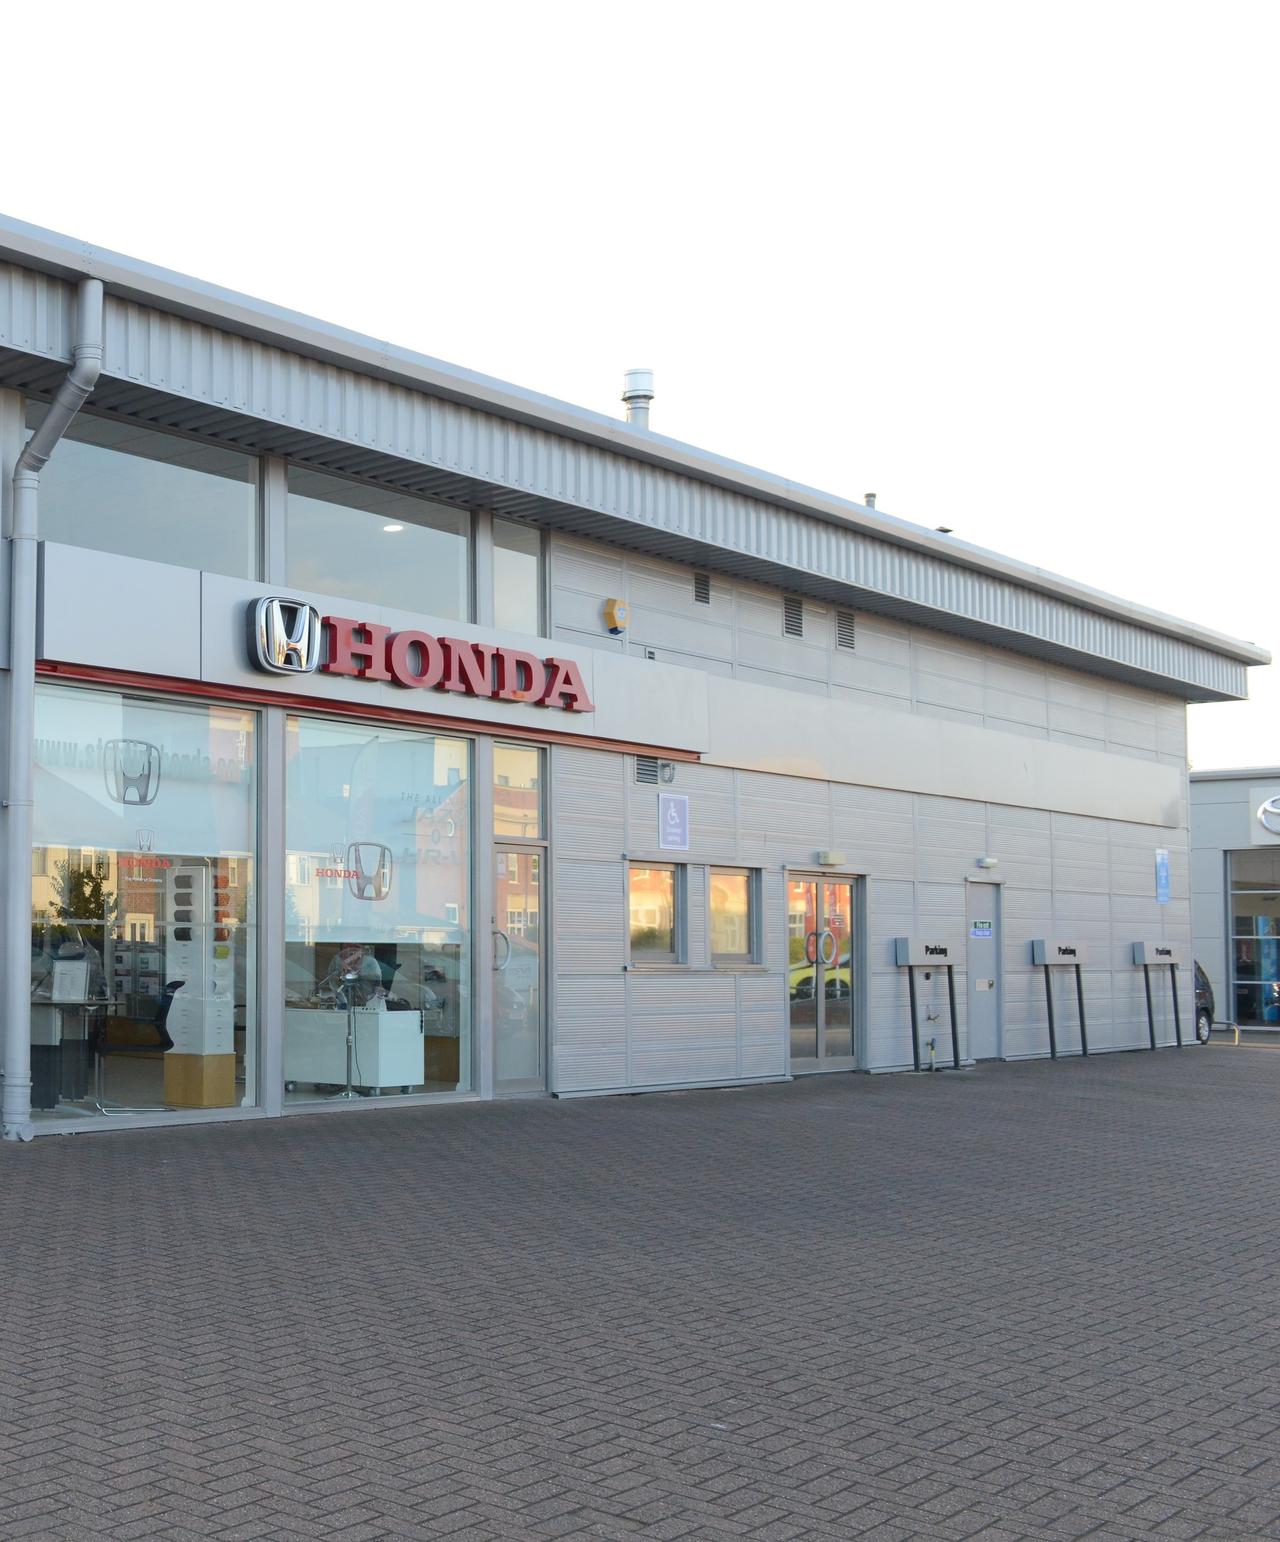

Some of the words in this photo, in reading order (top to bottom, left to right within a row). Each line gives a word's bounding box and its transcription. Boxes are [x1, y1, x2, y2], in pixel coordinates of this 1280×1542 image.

[321, 615, 595, 713] HONDA
[315, 867, 361, 879] HONDA
[924, 945, 948, 958] Parking
[1057, 945, 1077, 958] Parking
